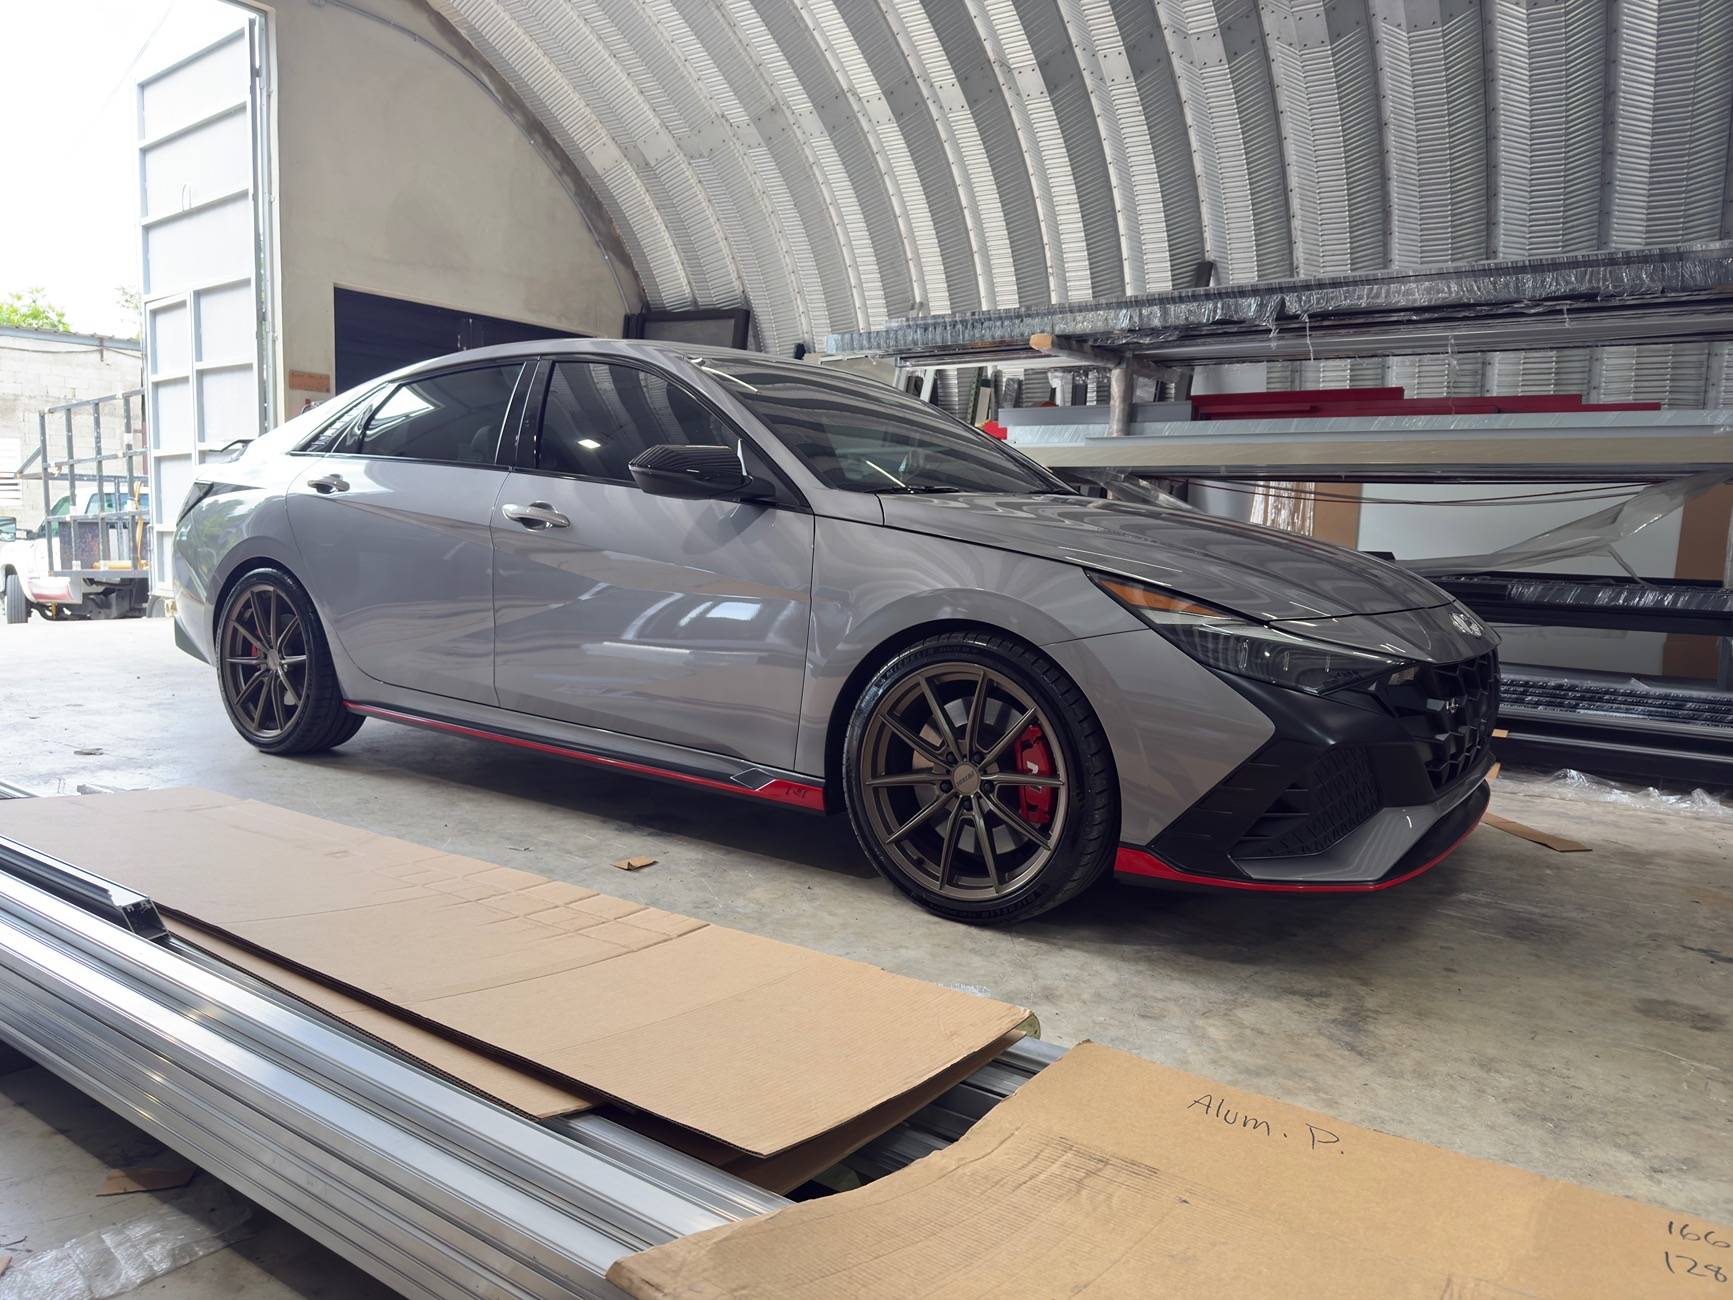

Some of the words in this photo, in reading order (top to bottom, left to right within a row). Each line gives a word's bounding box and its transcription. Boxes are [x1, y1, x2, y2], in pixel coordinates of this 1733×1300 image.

[1187, 1094, 1287, 1138] Alum.
[1668, 1220, 1731, 1248] 166
[1664, 1251, 1728, 1282] 128
